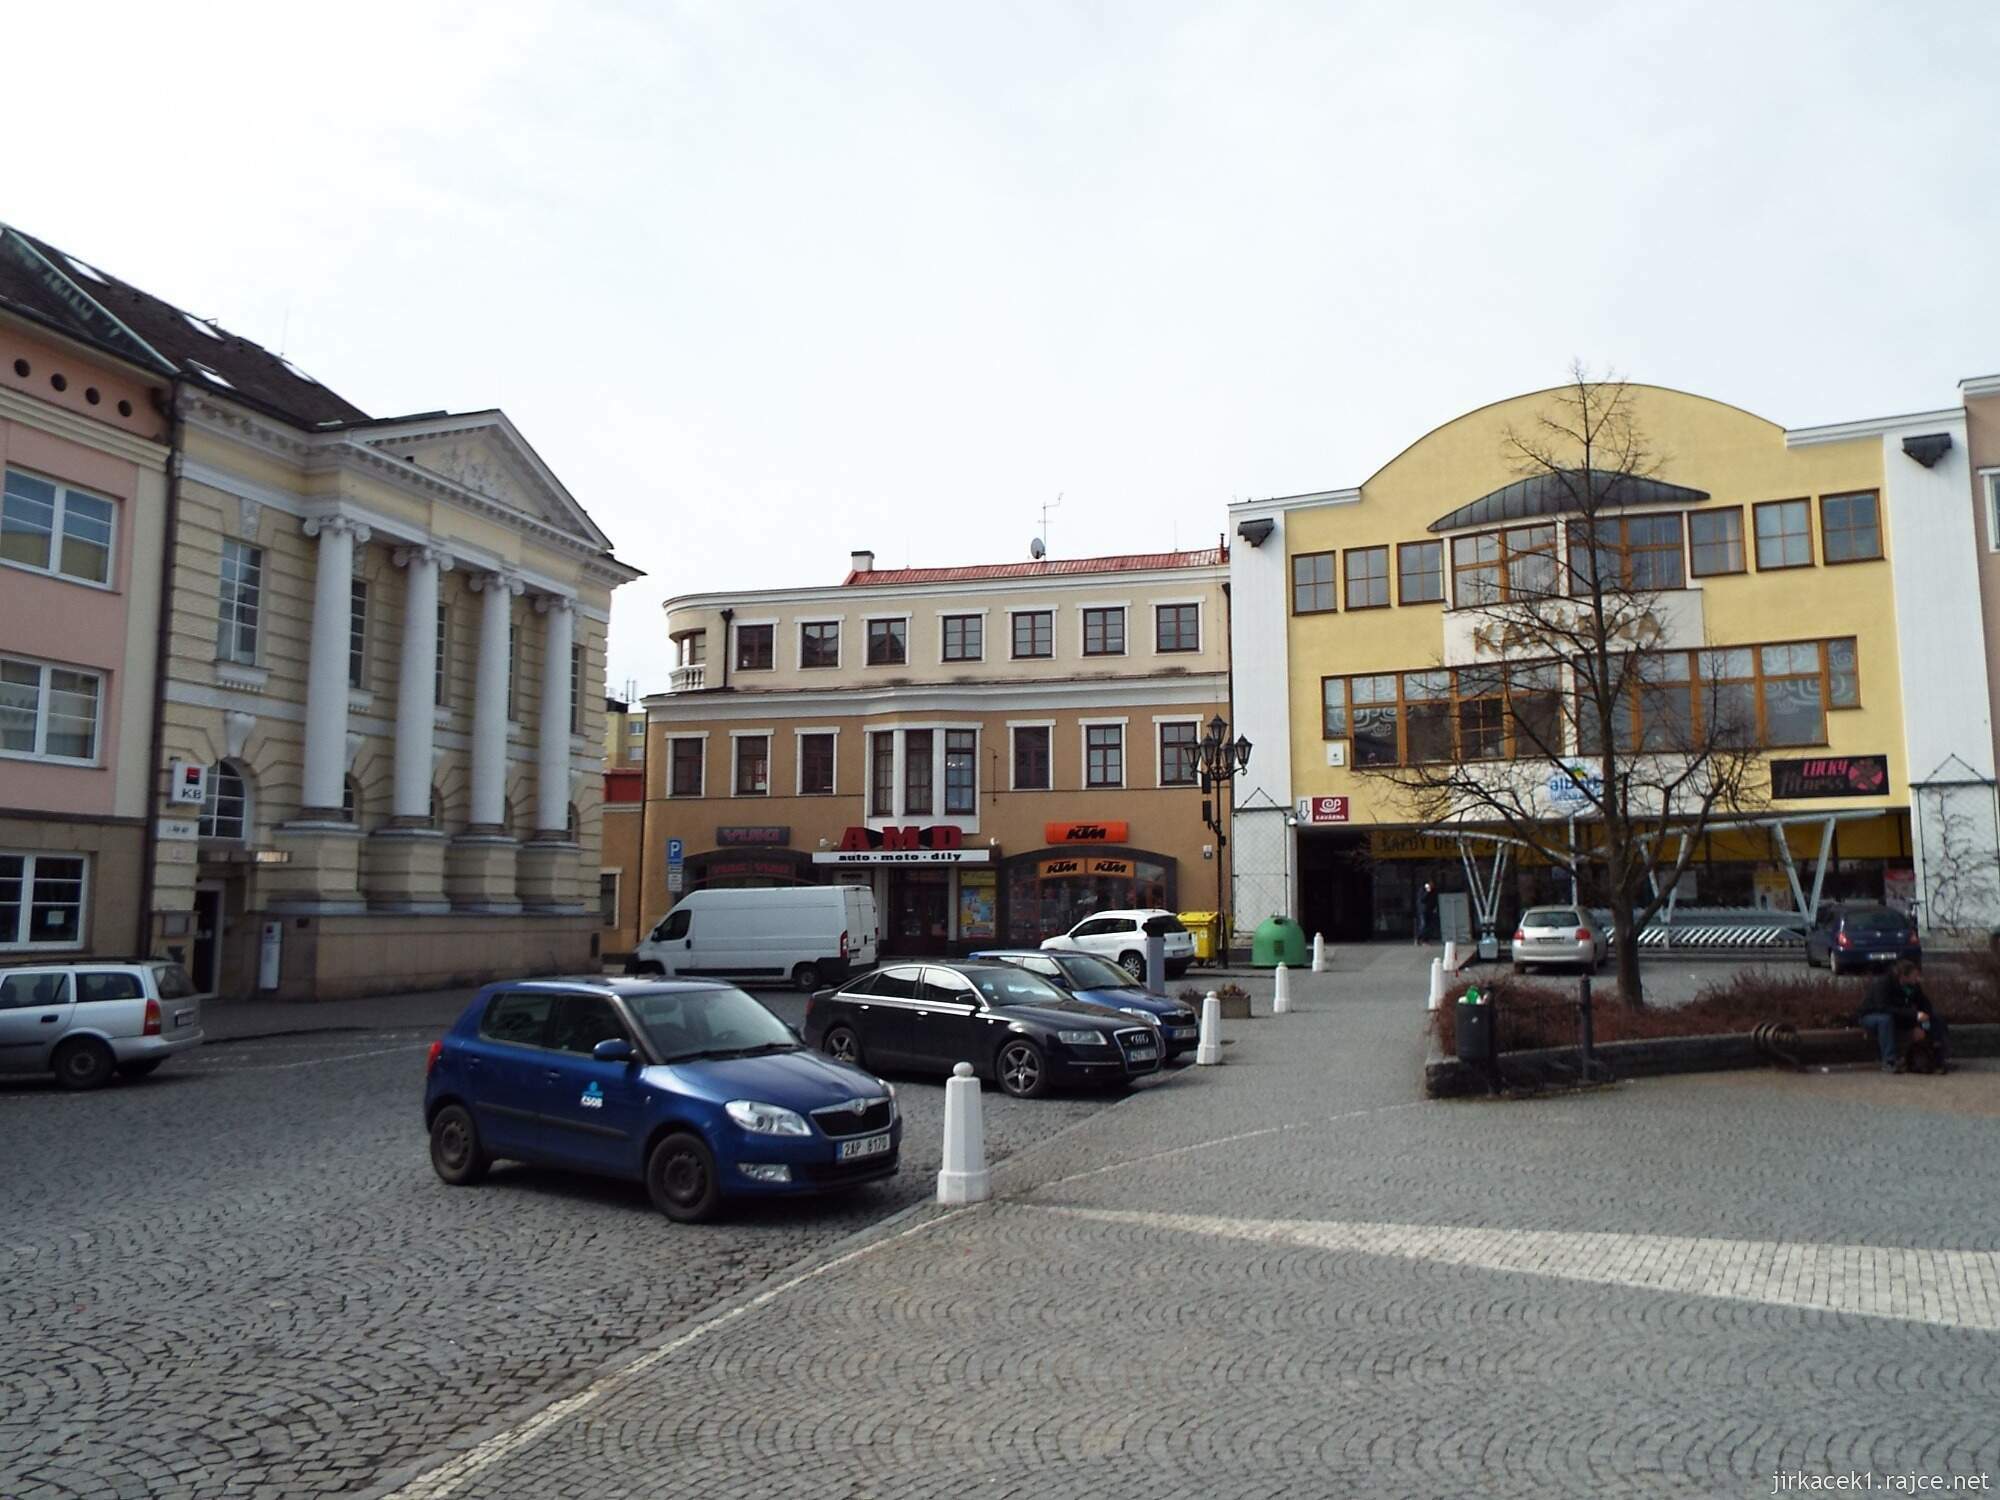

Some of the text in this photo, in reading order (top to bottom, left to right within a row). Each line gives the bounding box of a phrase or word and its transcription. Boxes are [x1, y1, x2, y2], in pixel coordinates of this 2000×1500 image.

[1550, 776, 1601, 791] albrt
[181, 788, 202, 799] KB
[840, 826, 962, 850] AMD
[1066, 825, 1106, 839] KTM
[671, 841, 680, 857] P
[880, 853, 919, 861] moto
[1046, 861, 1077, 873] KTM
[1095, 861, 1126, 873] KTM
